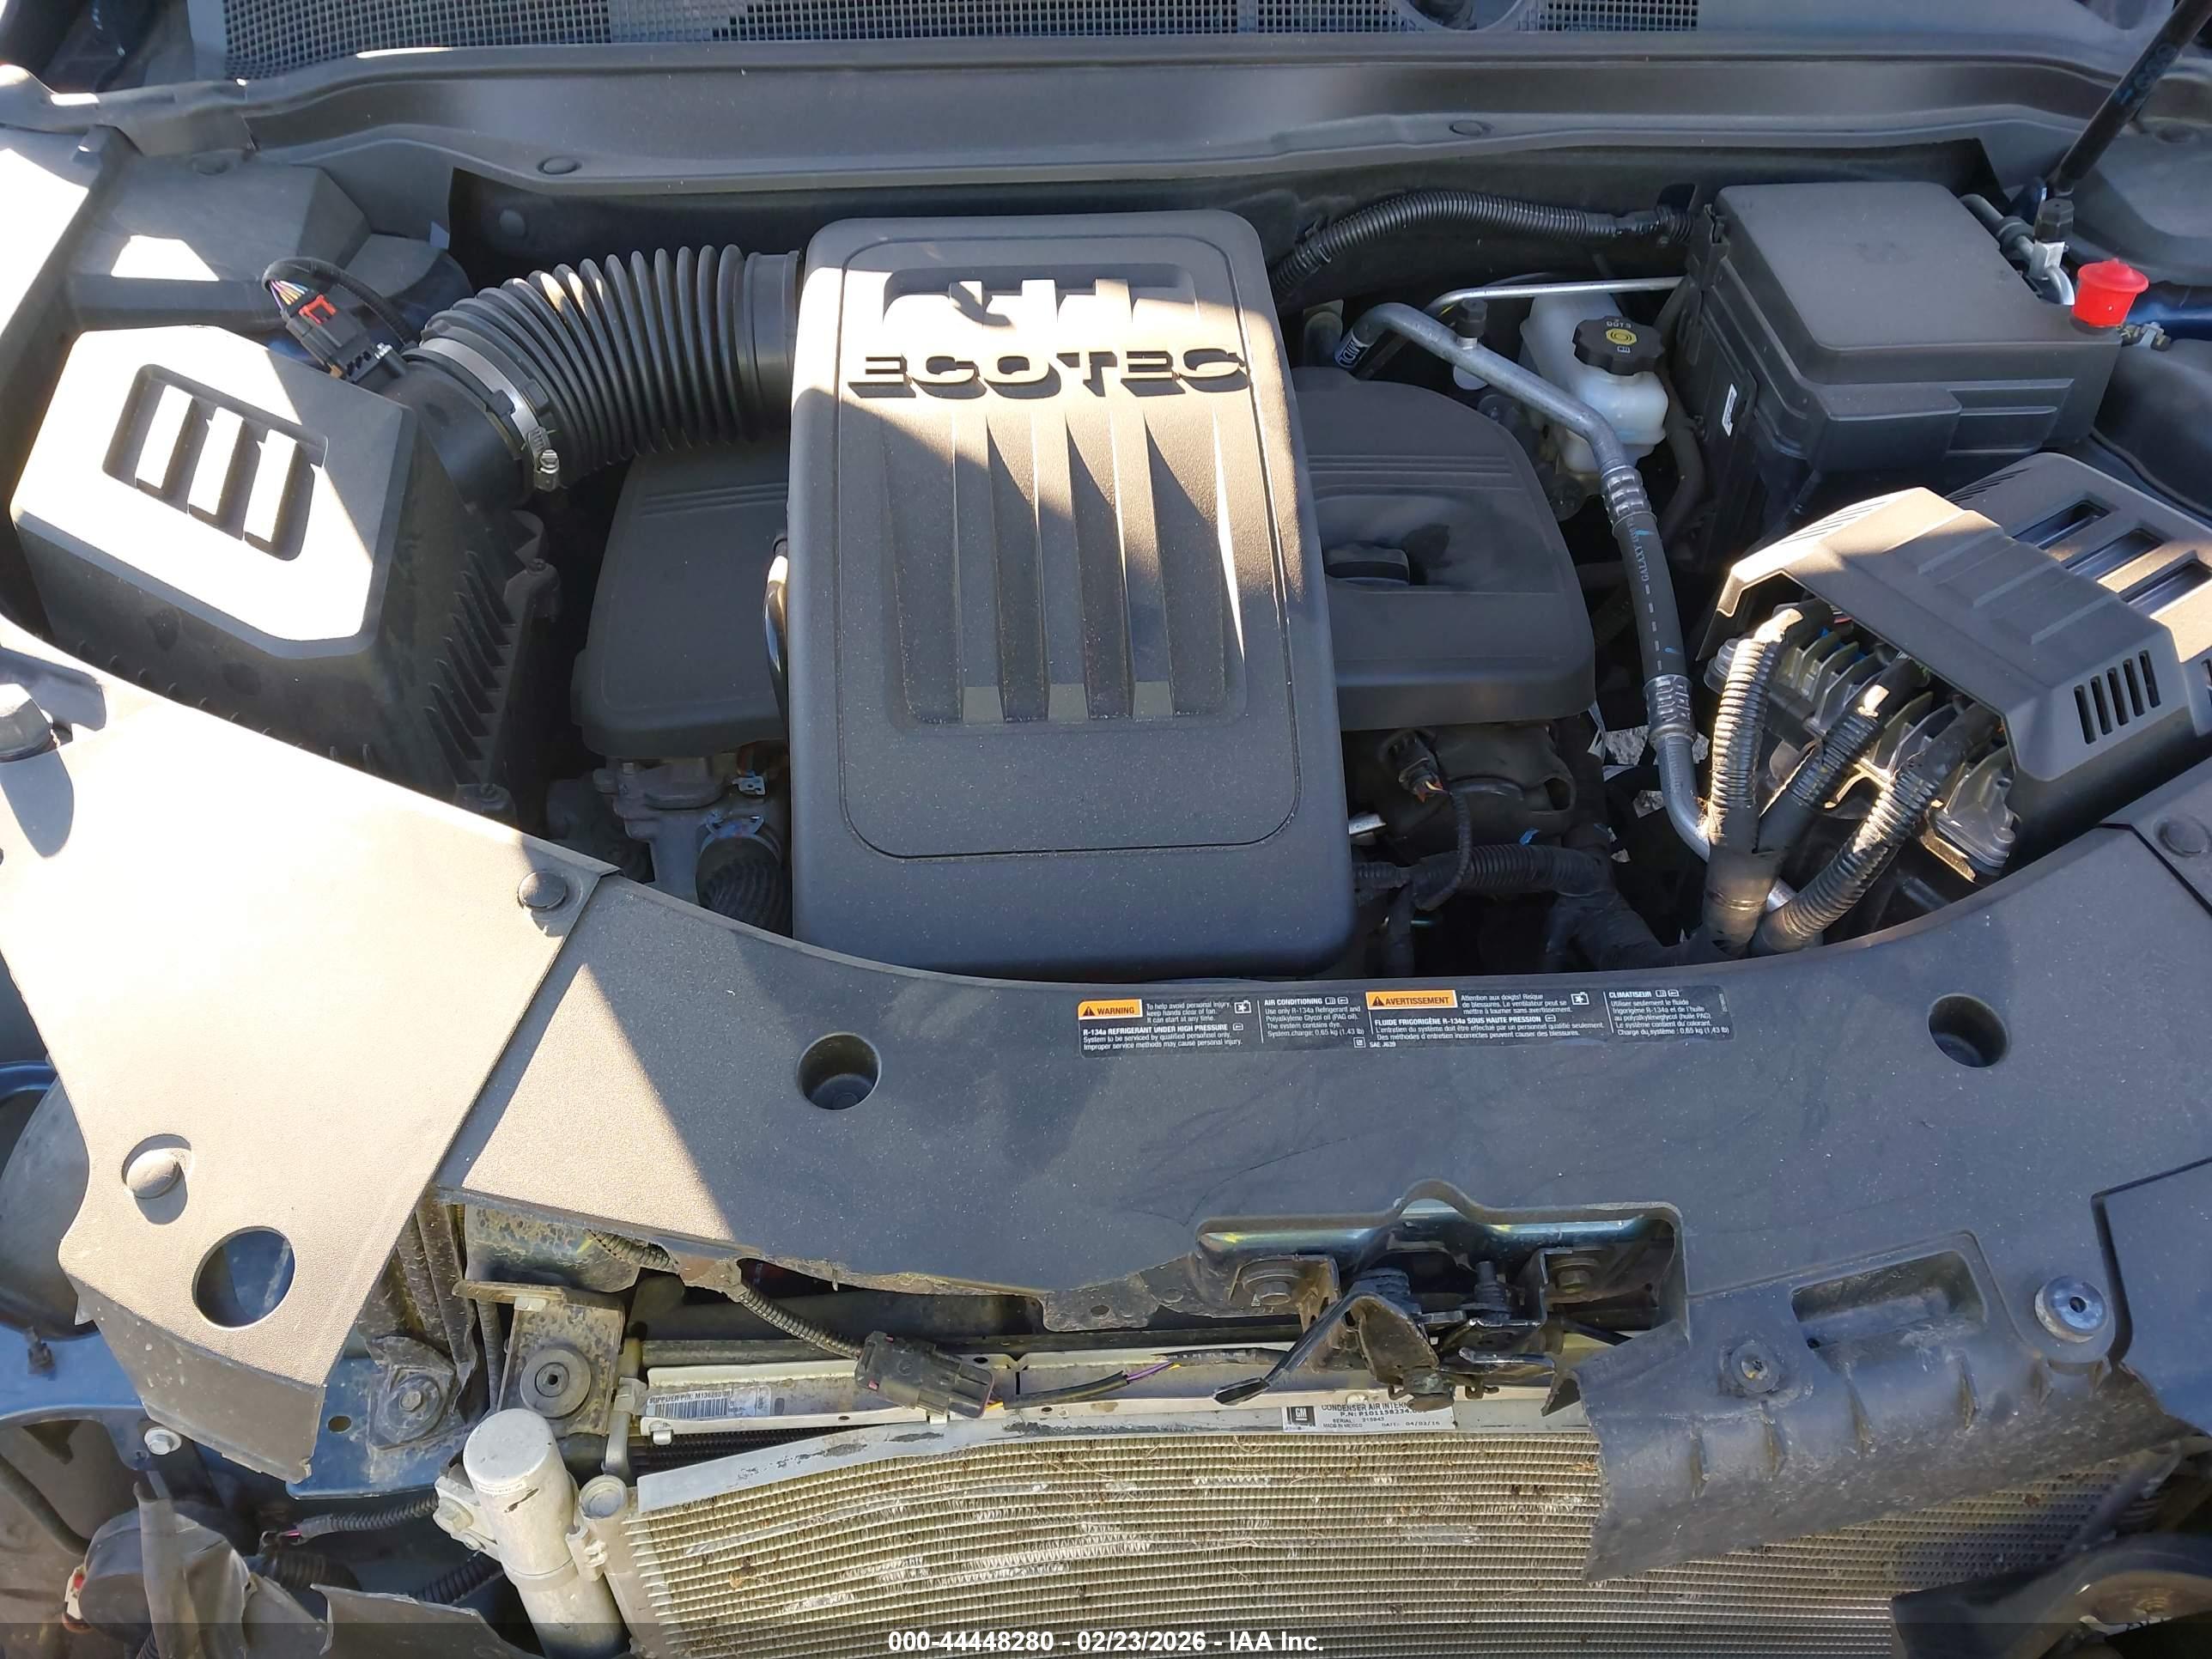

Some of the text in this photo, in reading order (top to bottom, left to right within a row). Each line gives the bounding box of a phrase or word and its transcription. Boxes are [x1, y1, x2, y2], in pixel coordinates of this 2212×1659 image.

[850, 345, 1249, 397] ECOTEC
[1634, 545, 1650, 581] GALAXY
[1386, 996, 1449, 1005] AVERTISSEMENT
[1097, 1006, 1134, 1015] WARNING
[1295, 1407, 1307, 1417] GM
